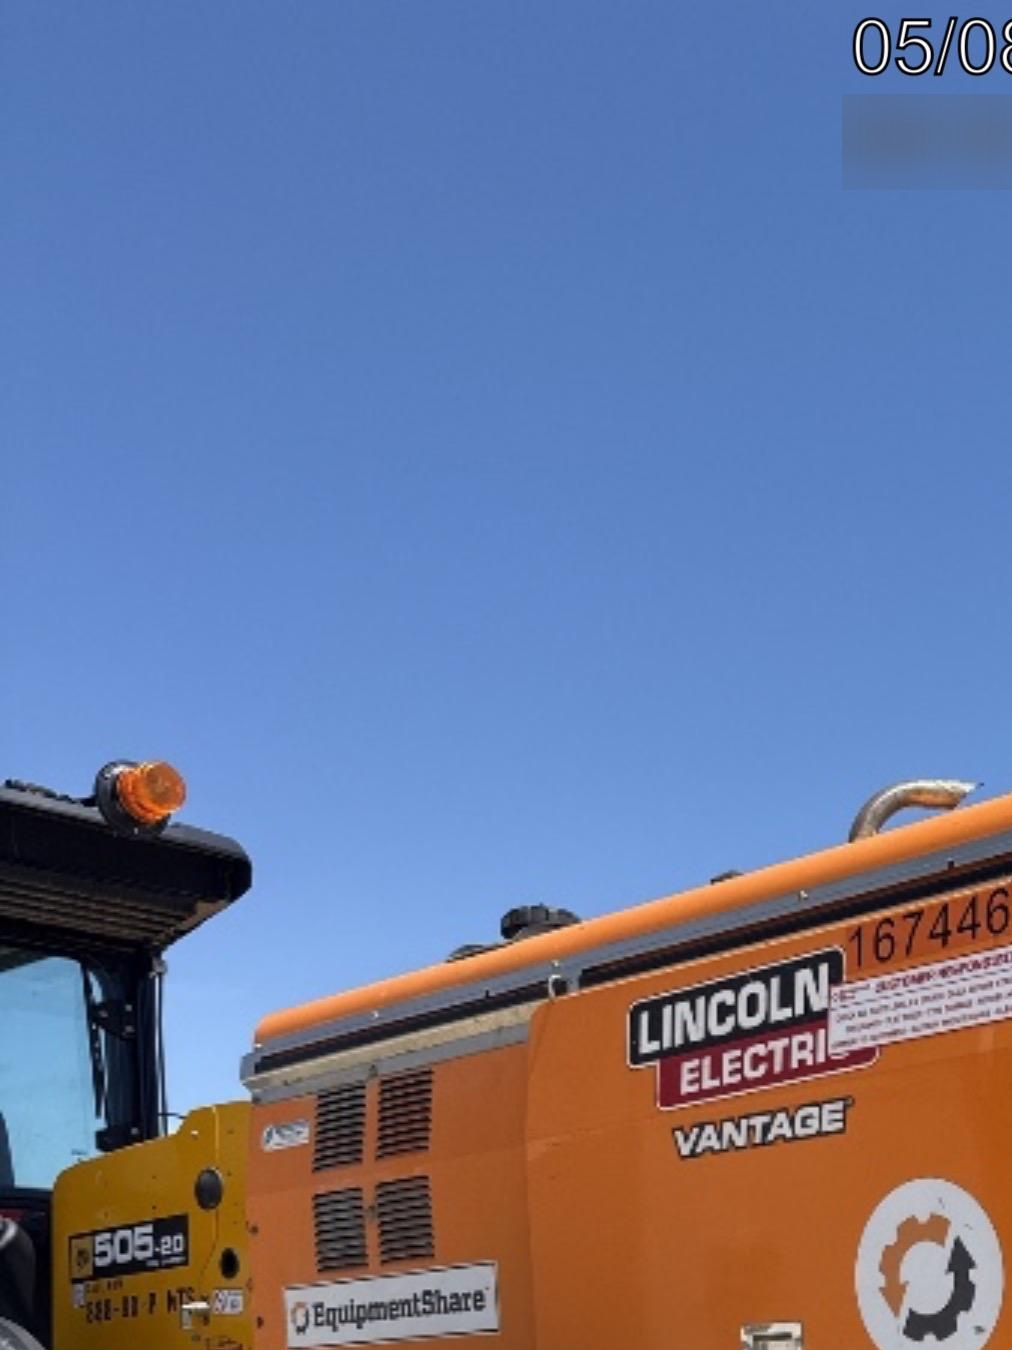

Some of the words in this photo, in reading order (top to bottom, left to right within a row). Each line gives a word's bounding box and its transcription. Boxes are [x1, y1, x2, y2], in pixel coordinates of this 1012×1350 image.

[850, 888, 1010, 968] 167446
[638, 962, 829, 1054] LINCOLN
[679, 1028, 849, 1096] ELECTRI
[673, 1100, 845, 1158] VANTAGE
[94, 1222, 185, 1268] 505-20
[313, 1289, 487, 1332] EquipmentShare
